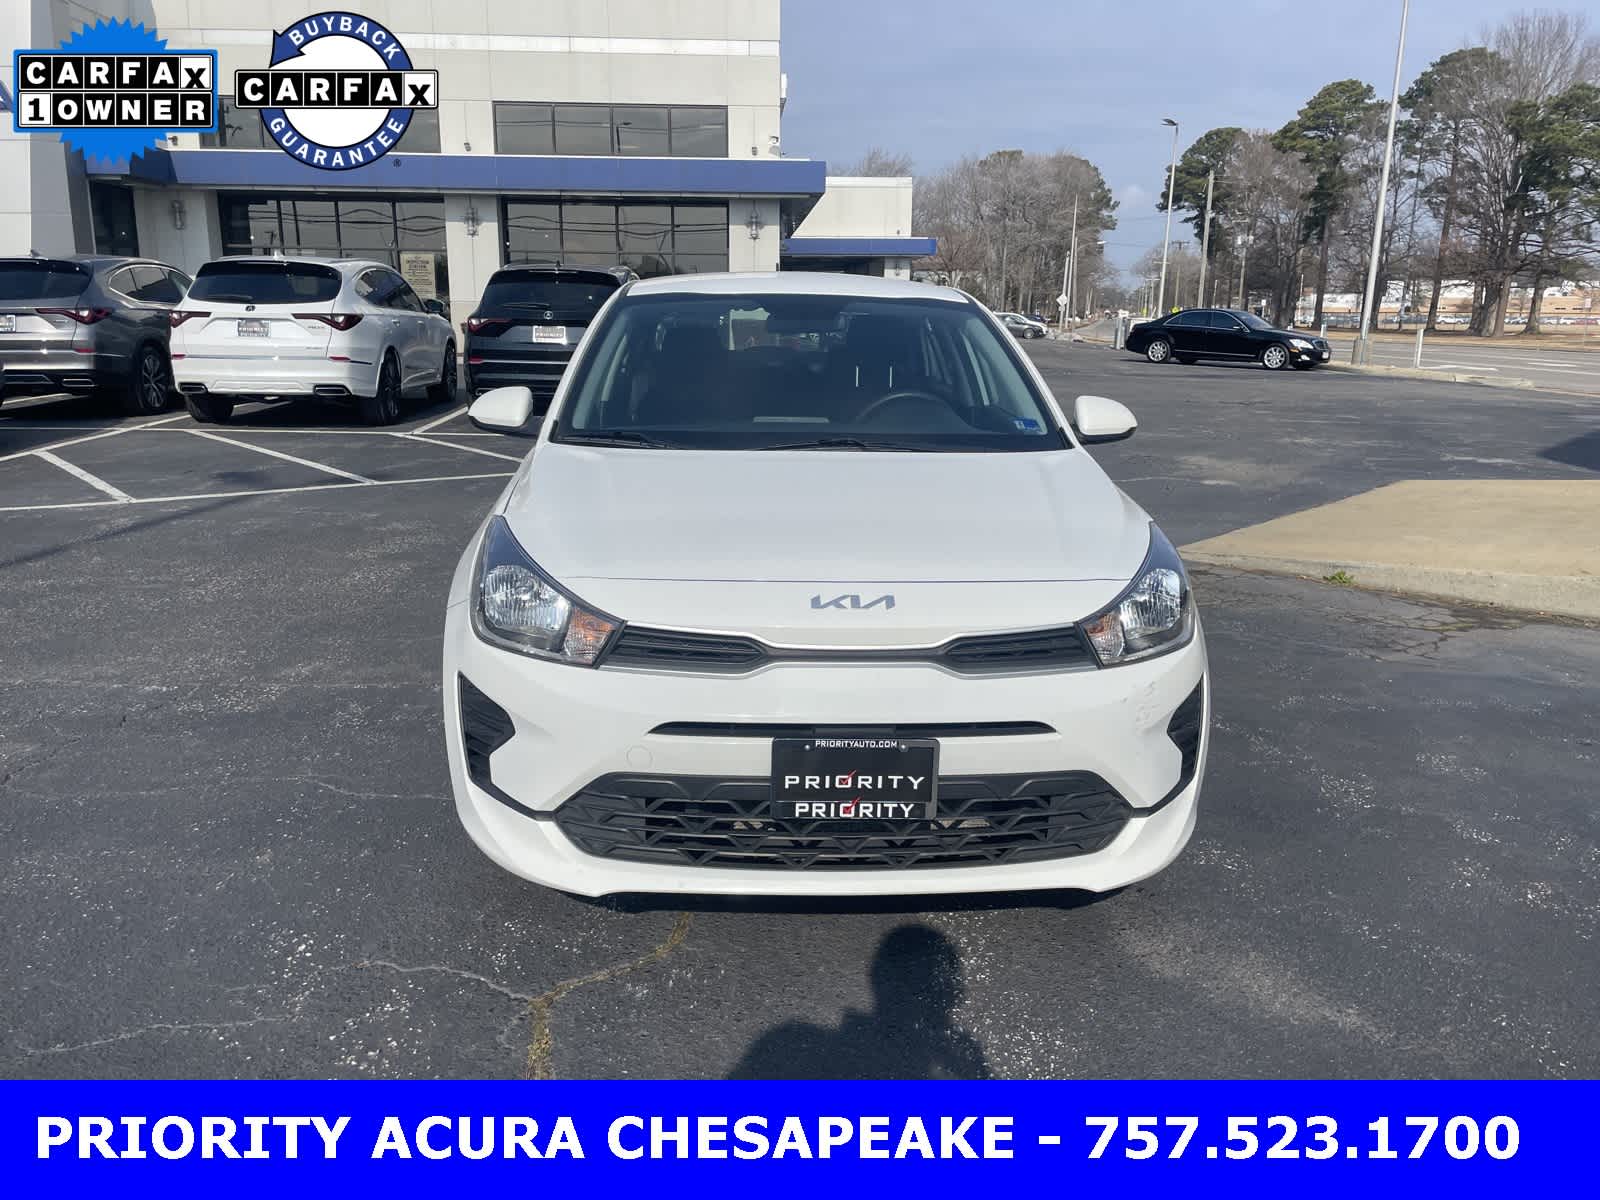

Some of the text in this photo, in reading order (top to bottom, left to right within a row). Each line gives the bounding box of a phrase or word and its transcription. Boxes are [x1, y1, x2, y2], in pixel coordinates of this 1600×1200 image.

[810, 594, 896, 611] KIA
[815, 740, 898, 749] PRIORITYAUTO.COM
[784, 775, 926, 790] PRIORITY
[795, 803, 915, 818] PRIORITY
